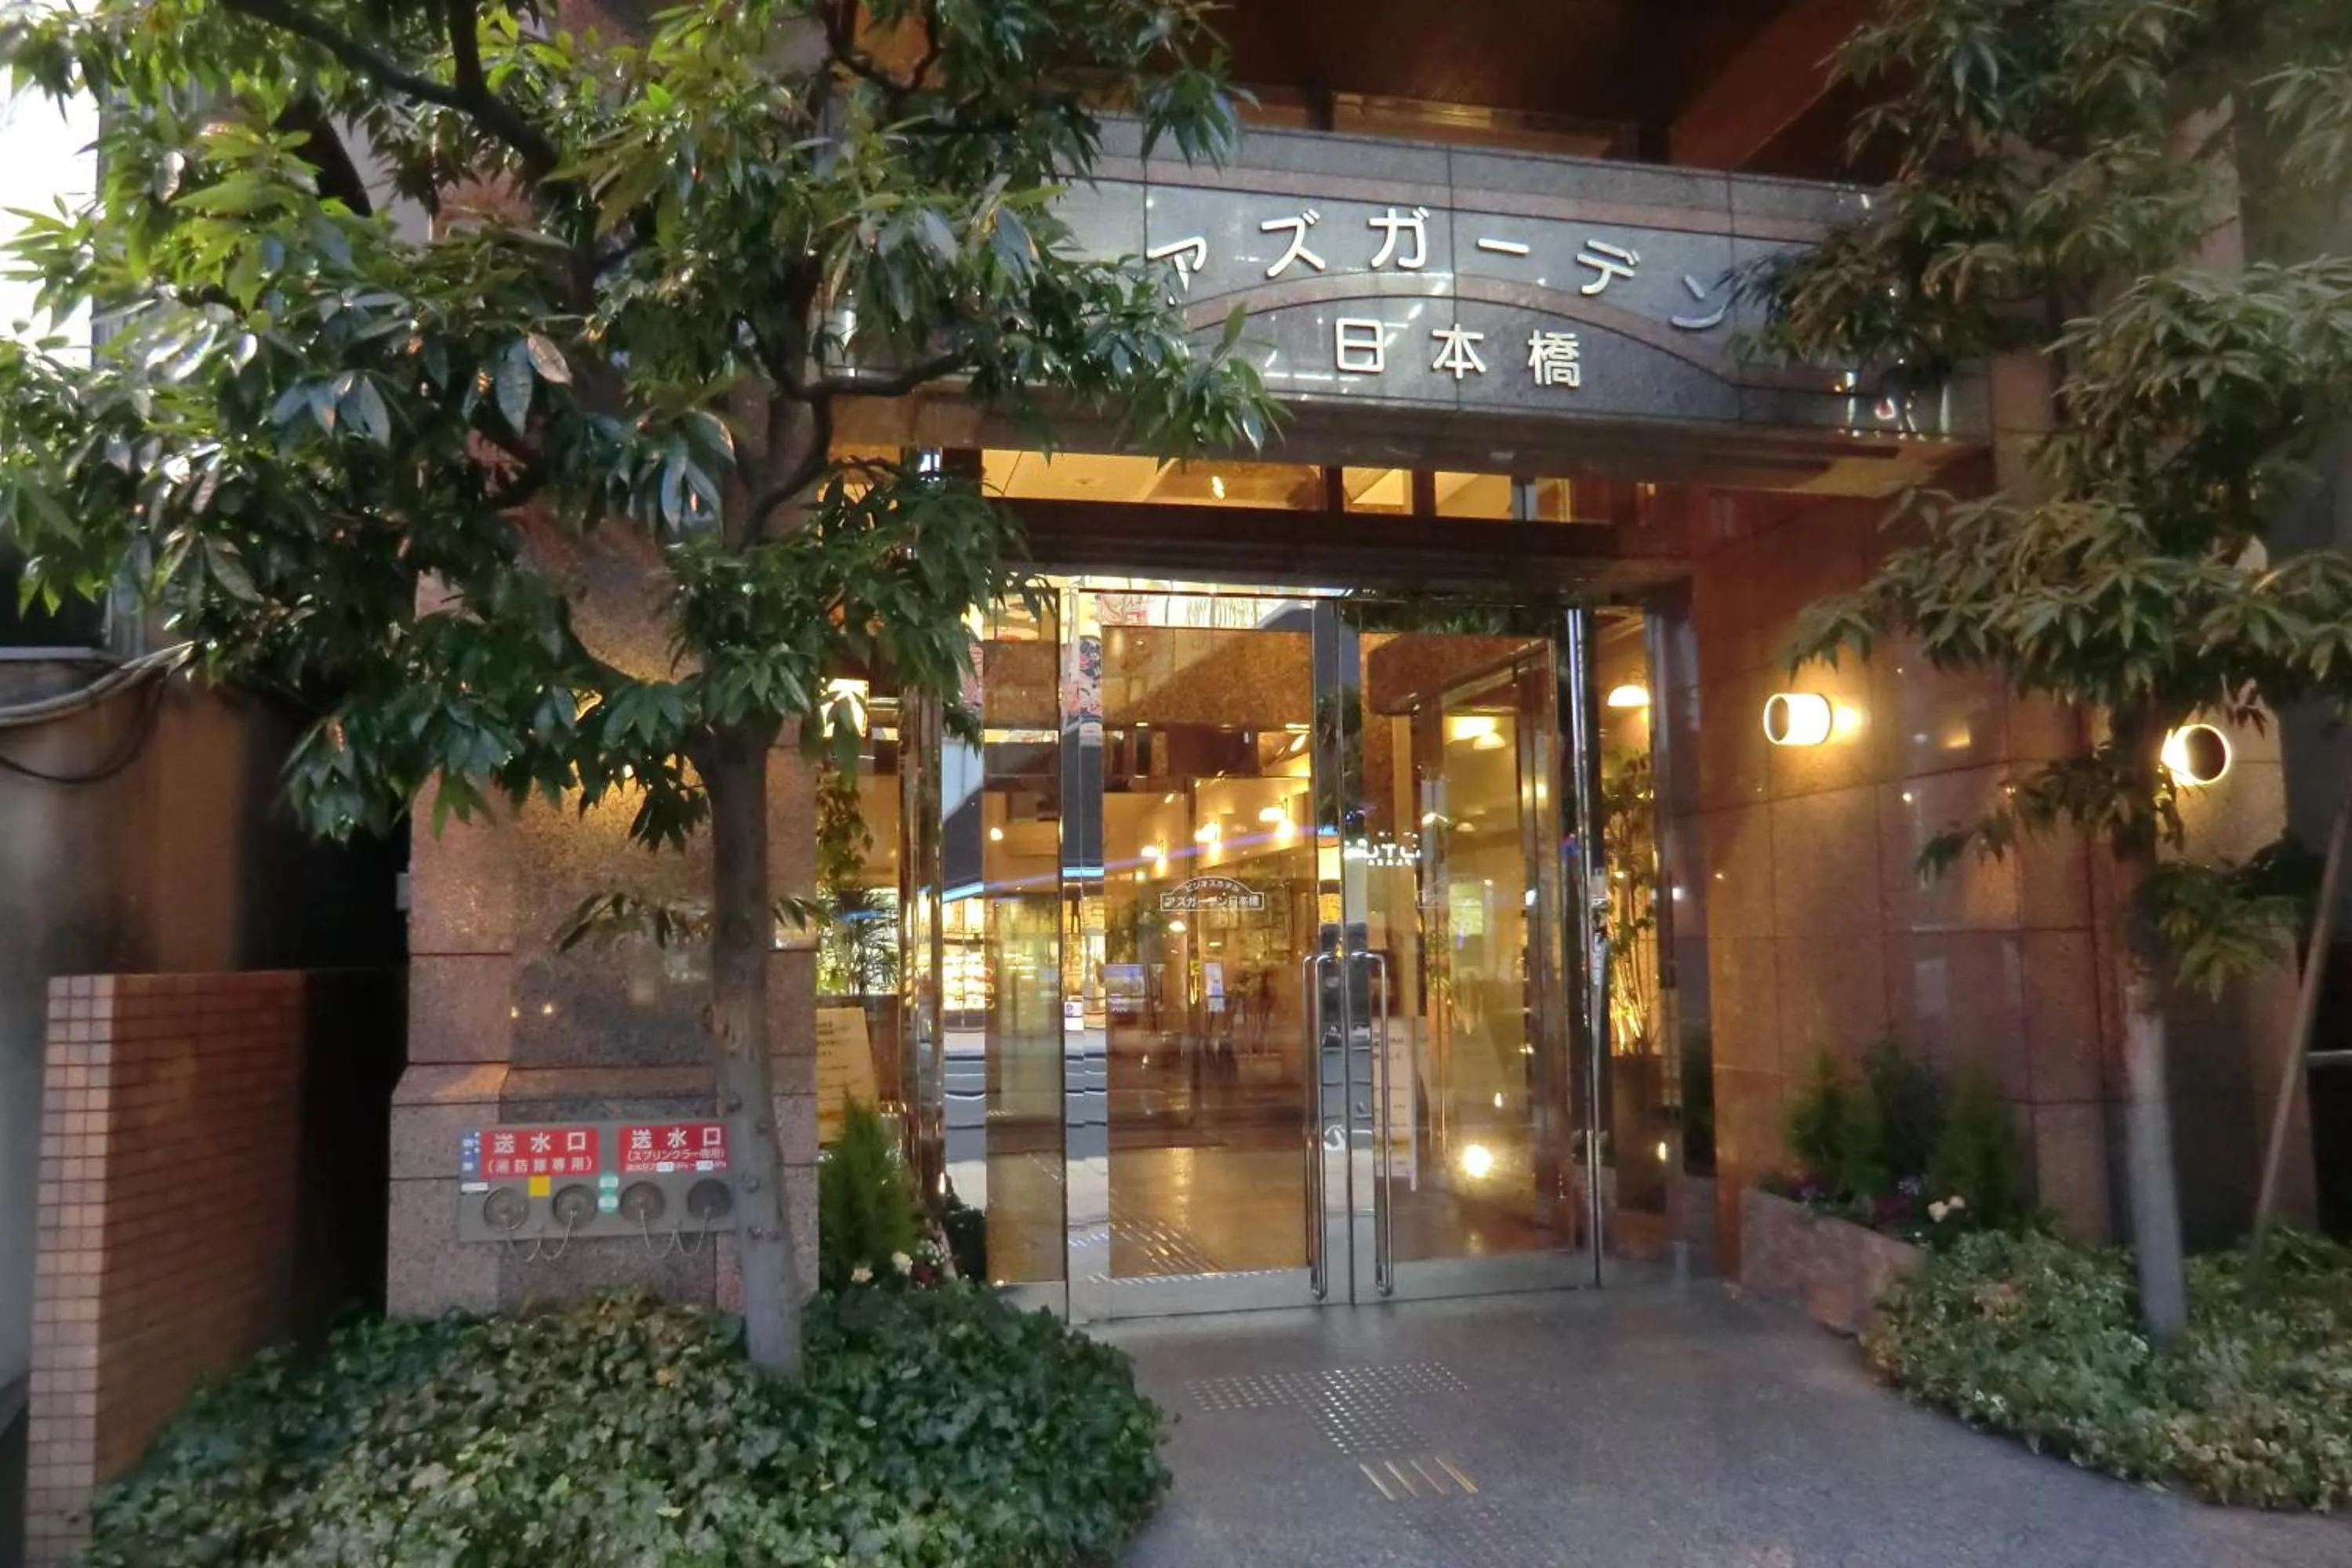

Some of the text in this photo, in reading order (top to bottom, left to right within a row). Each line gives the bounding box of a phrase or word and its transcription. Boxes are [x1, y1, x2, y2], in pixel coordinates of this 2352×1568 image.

[1333, 318, 1581, 388] 日本橋
[494, 1131, 586, 1154] 送水口
[631, 1127, 721, 1149] 送水口
